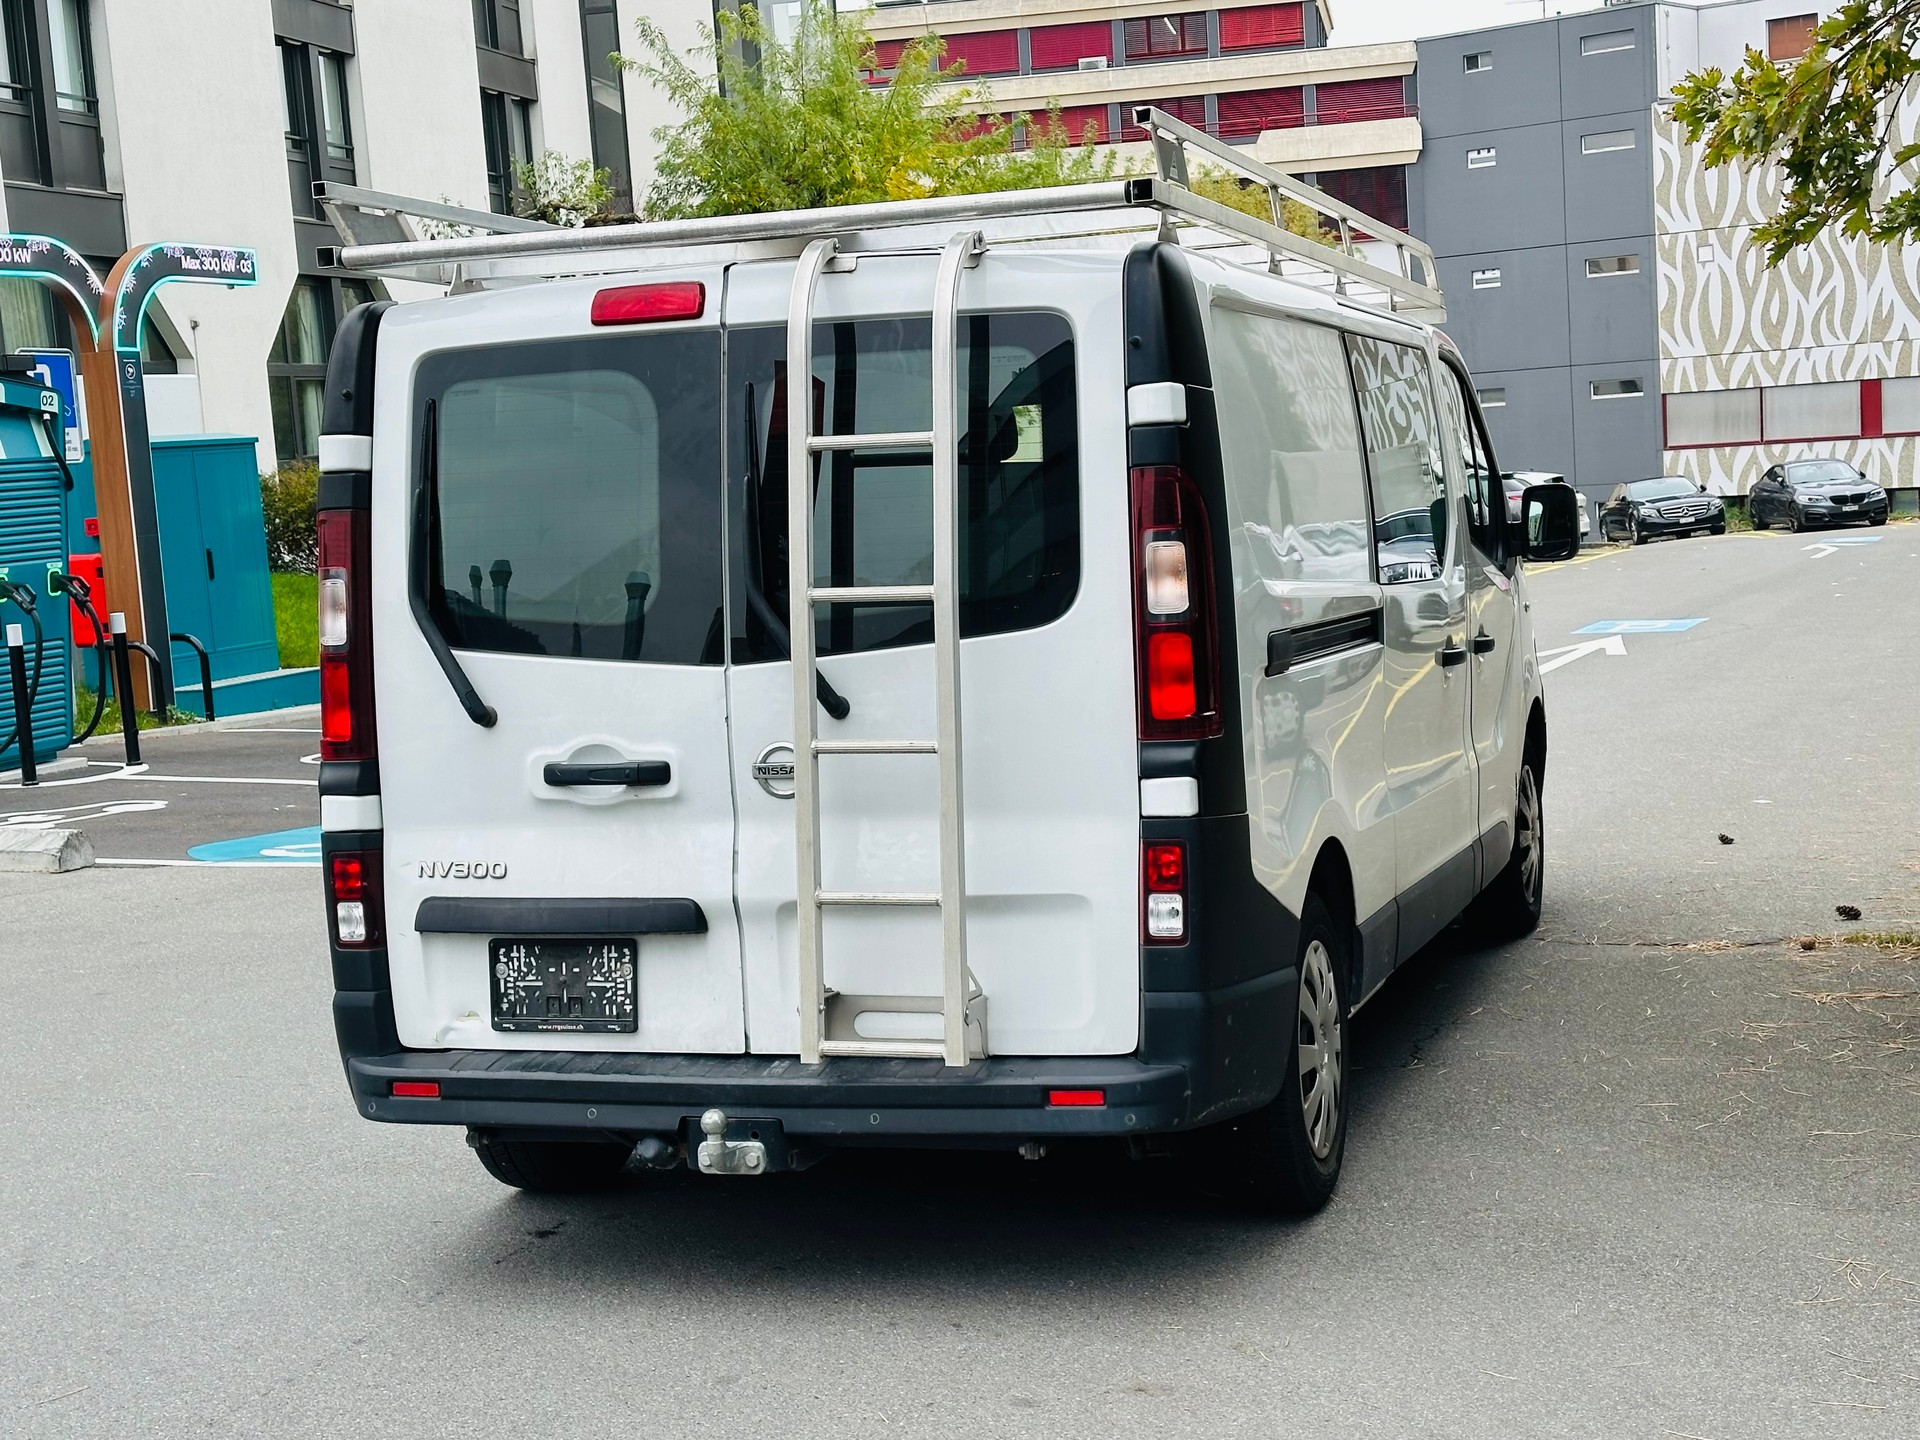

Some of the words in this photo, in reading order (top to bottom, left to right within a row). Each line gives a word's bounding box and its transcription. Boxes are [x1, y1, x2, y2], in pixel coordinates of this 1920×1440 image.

[12, 247, 31, 263] kW
[181, 255, 201, 270] Max
[202, 257, 220, 271] 300
[220, 258, 235, 272] kW
[240, 260, 253, 273] 03
[41, 395, 54, 406] 02
[757, 766, 795, 775] NISSA
[418, 861, 507, 879] NV300
